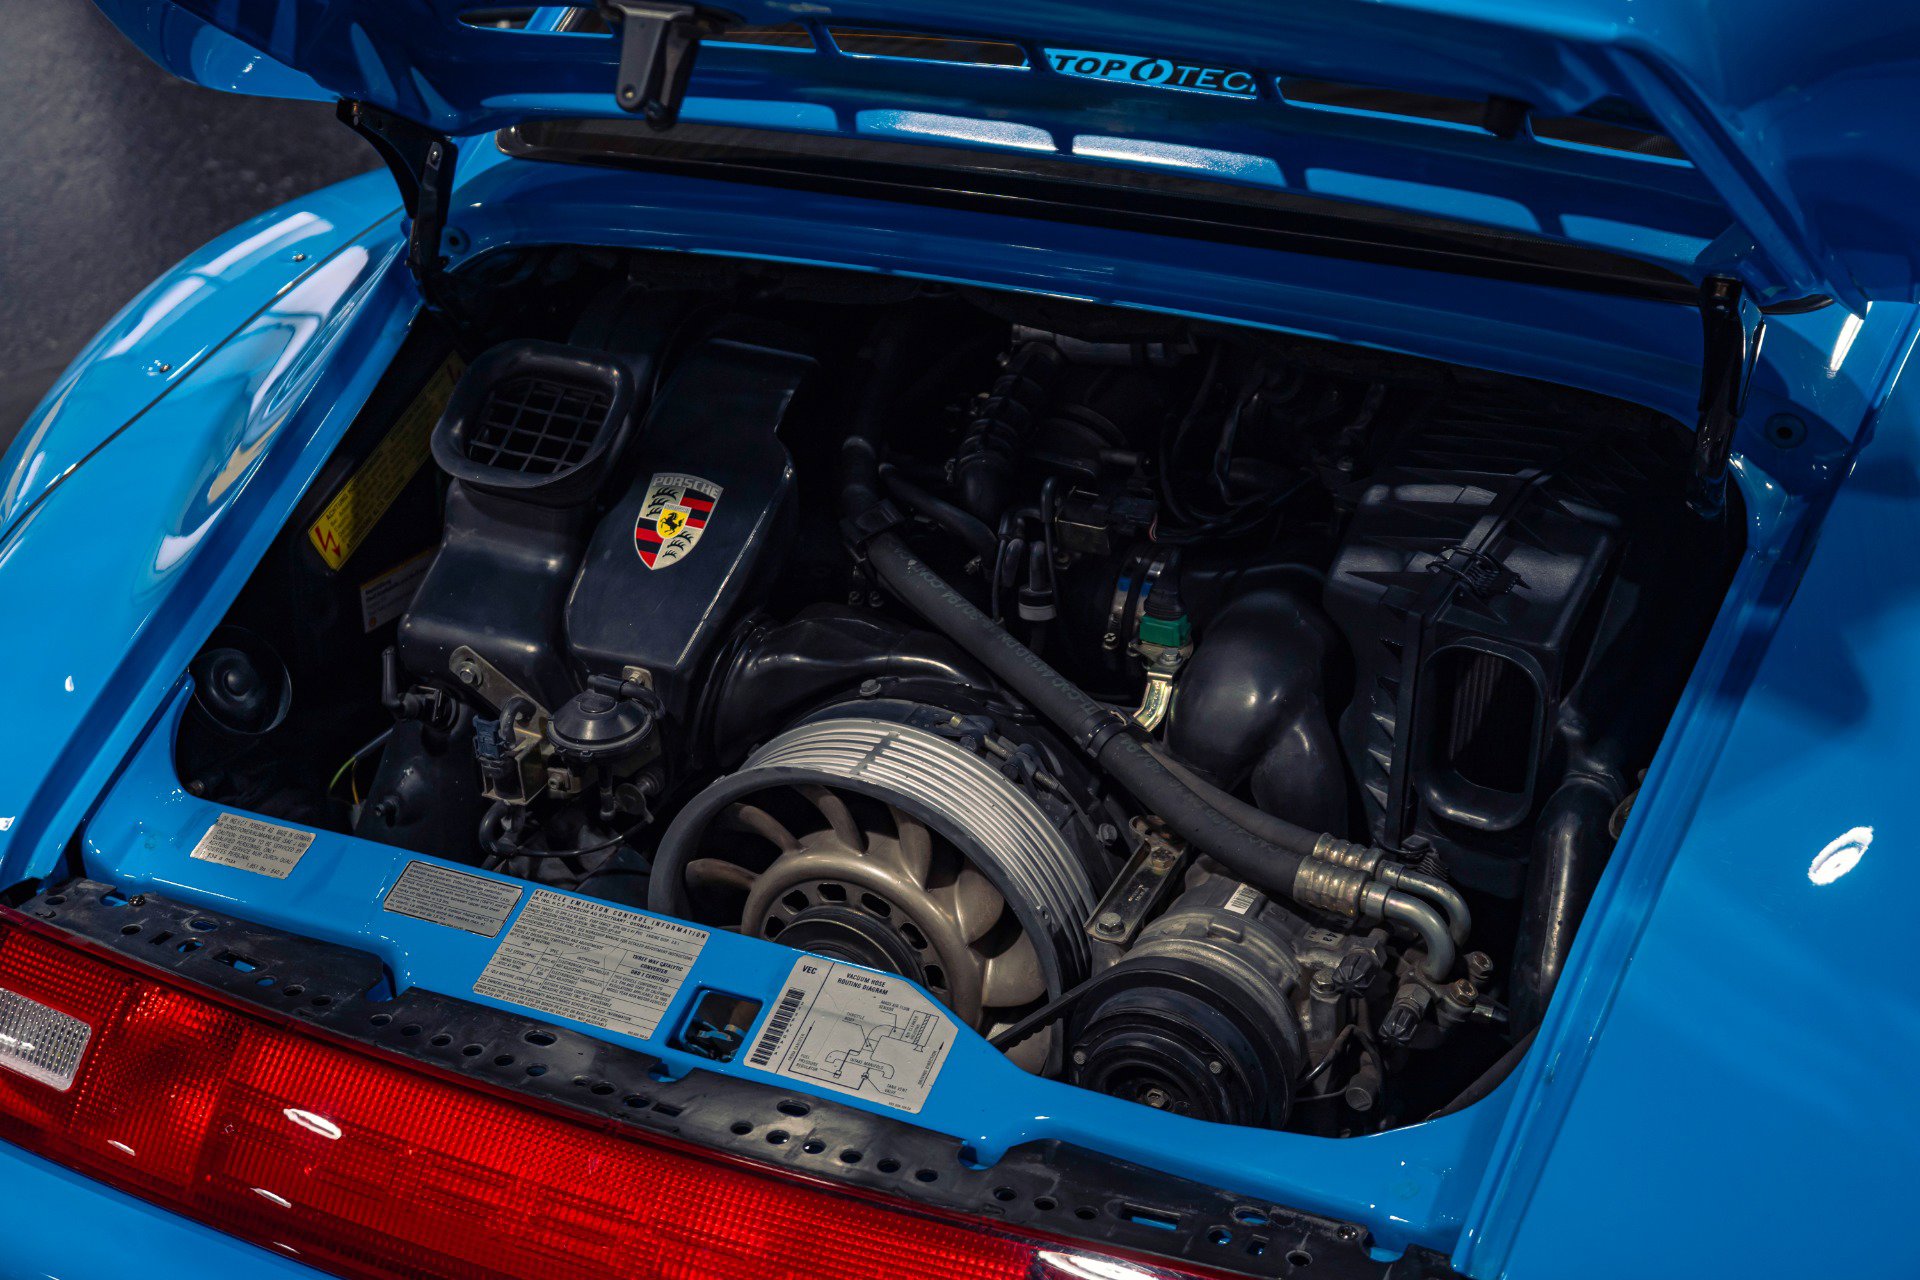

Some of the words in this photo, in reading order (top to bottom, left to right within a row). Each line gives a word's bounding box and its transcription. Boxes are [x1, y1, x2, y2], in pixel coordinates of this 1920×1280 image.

[1055, 54, 1127, 77] TOP
[652, 476, 720, 499] PORSCHE
[535, 890, 566, 902] VEHICLE
[570, 899, 609, 913] EMISSION
[612, 910, 647, 923] CONTROL
[651, 920, 706, 938] INFORMATION
[566, 905, 589, 913] PORSCHE
[598, 913, 626, 923] STUTTGART
[629, 921, 653, 930] GERMANY
[632, 954, 648, 962] THREE
[659, 961, 683, 972] CATALYTIC
[640, 963, 668, 974] CONVERTER
[802, 965, 817, 974] VEC
[645, 973, 669, 983] CERTIFIED
[837, 977, 861, 988] ROUTING
[862, 984, 888, 995] DIAGRAM
[846, 973, 870, 983] VACUUM
